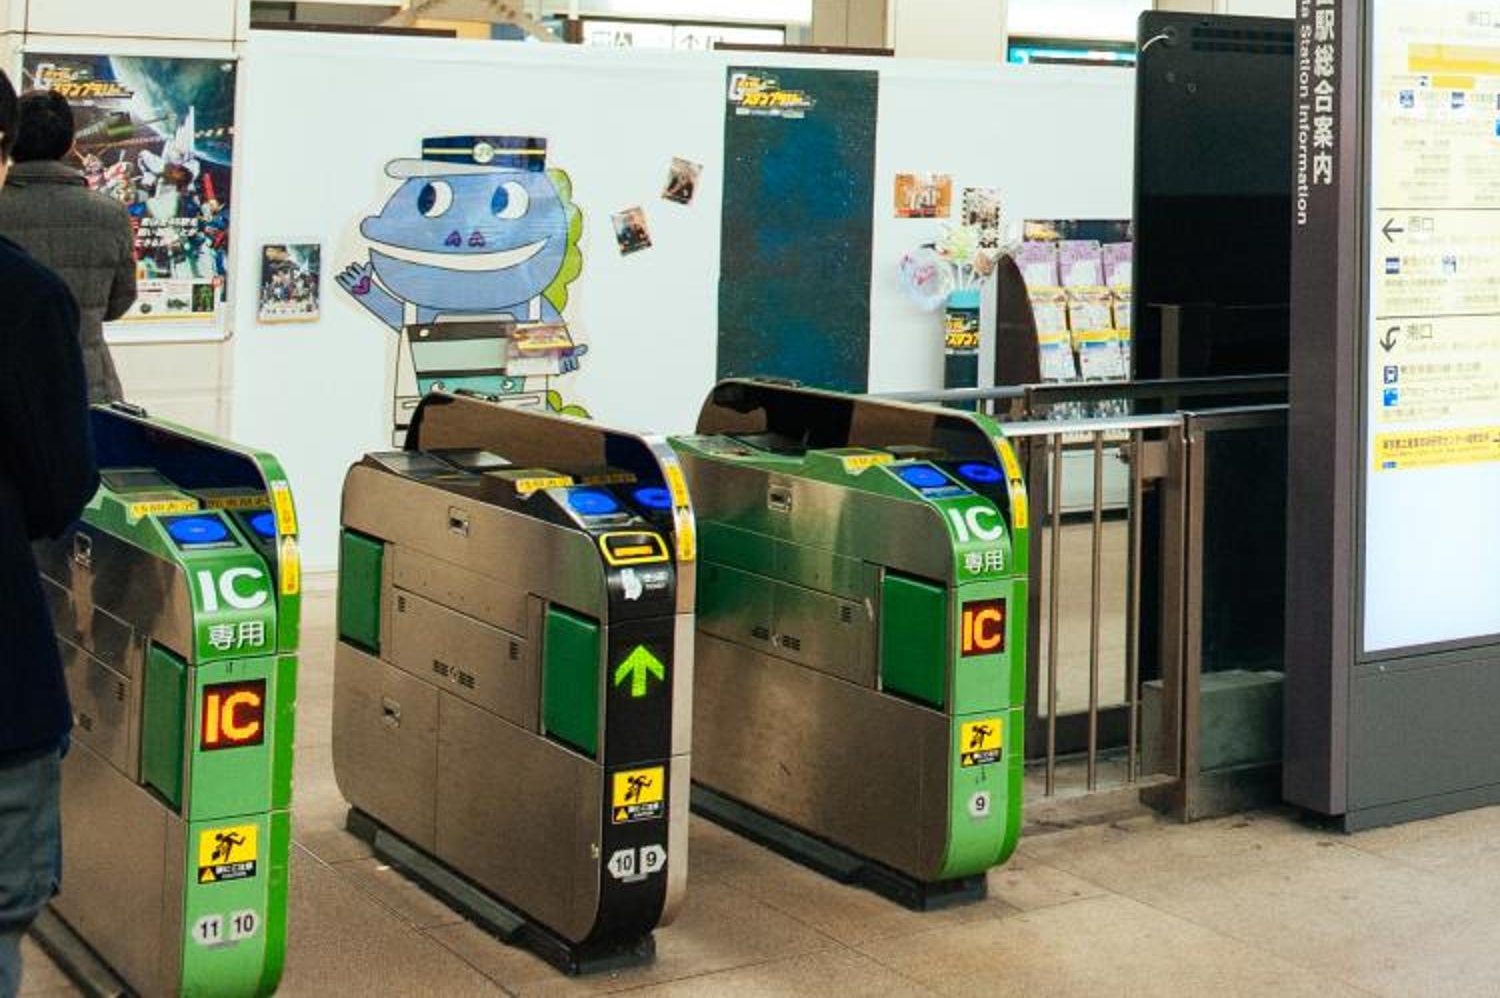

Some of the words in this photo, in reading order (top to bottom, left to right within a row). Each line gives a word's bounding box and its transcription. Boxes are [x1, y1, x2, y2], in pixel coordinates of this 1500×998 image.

[1299, 24, 1312, 98] Station
[1297, 104, 1310, 225] Information
[948, 506, 1003, 542] IC
[963, 550, 1003, 574] 専用
[197, 567, 268, 613] IC
[208, 620, 265, 650] 専用
[963, 608, 1001, 652] IC
[205, 690, 261, 744] IC
[975, 795, 986, 811] 9
[615, 855, 632, 872] 10
[646, 851, 657, 867] 9
[200, 921, 218, 938] 11
[234, 914, 254, 933] 10
